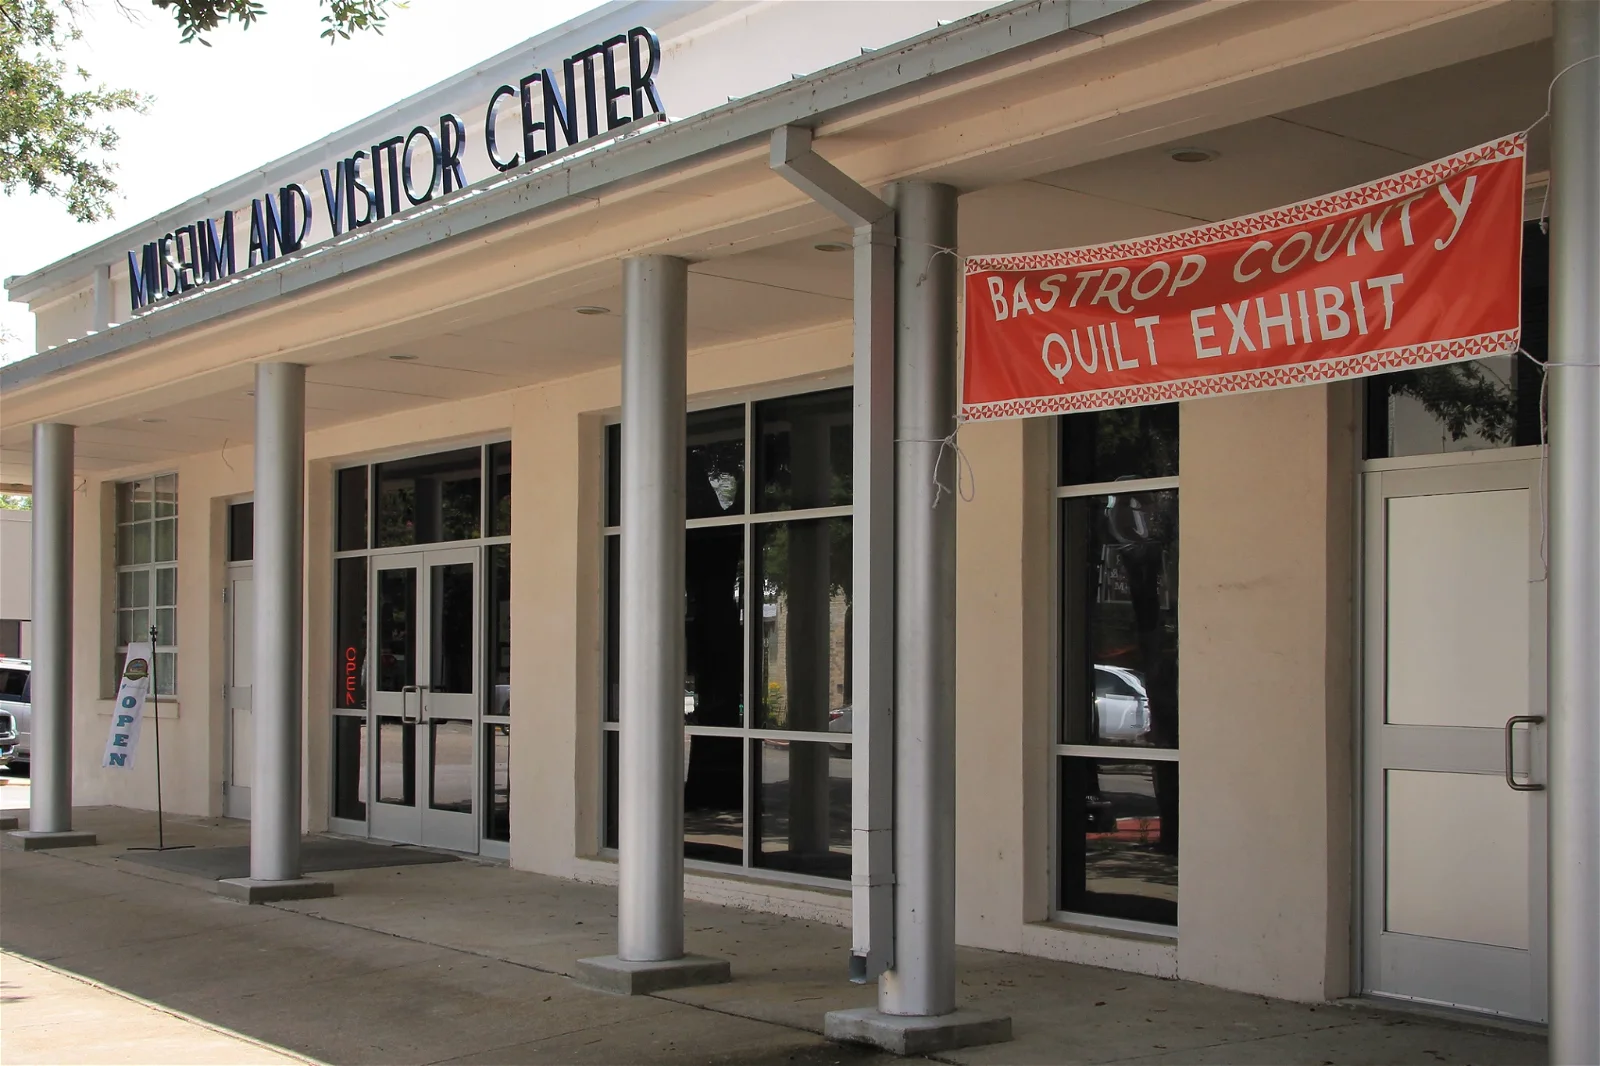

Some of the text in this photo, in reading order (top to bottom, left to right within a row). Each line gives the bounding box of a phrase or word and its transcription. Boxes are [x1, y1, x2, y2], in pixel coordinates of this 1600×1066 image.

[129, 26, 666, 310] MUSEUM AND VISITOR CENTER
[987, 175, 1477, 322] BASTROP COUNTY
[1041, 273, 1404, 385] QUILT EXHIBIT
[109, 696, 137, 767] OPEN
[345, 647, 356, 705] OPEN
